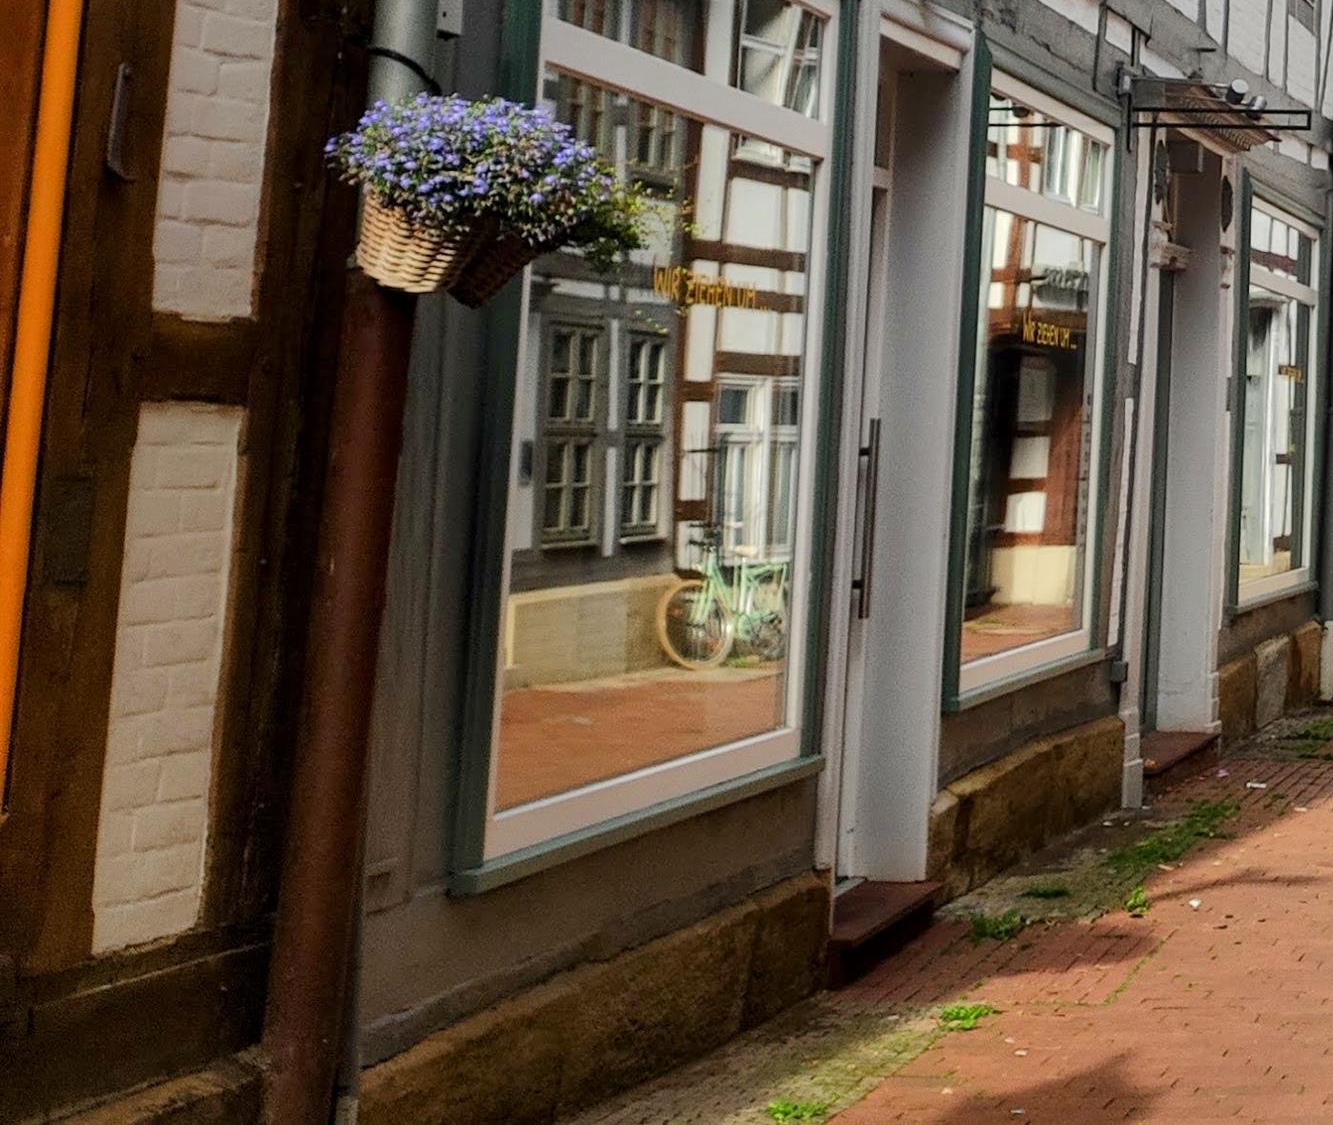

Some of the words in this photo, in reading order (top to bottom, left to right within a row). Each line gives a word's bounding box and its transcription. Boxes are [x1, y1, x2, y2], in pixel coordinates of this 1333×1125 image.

[653, 262, 679, 300] WIR
[685, 271, 733, 308] ZIEHEN
[1023, 310, 1035, 344] WIR
